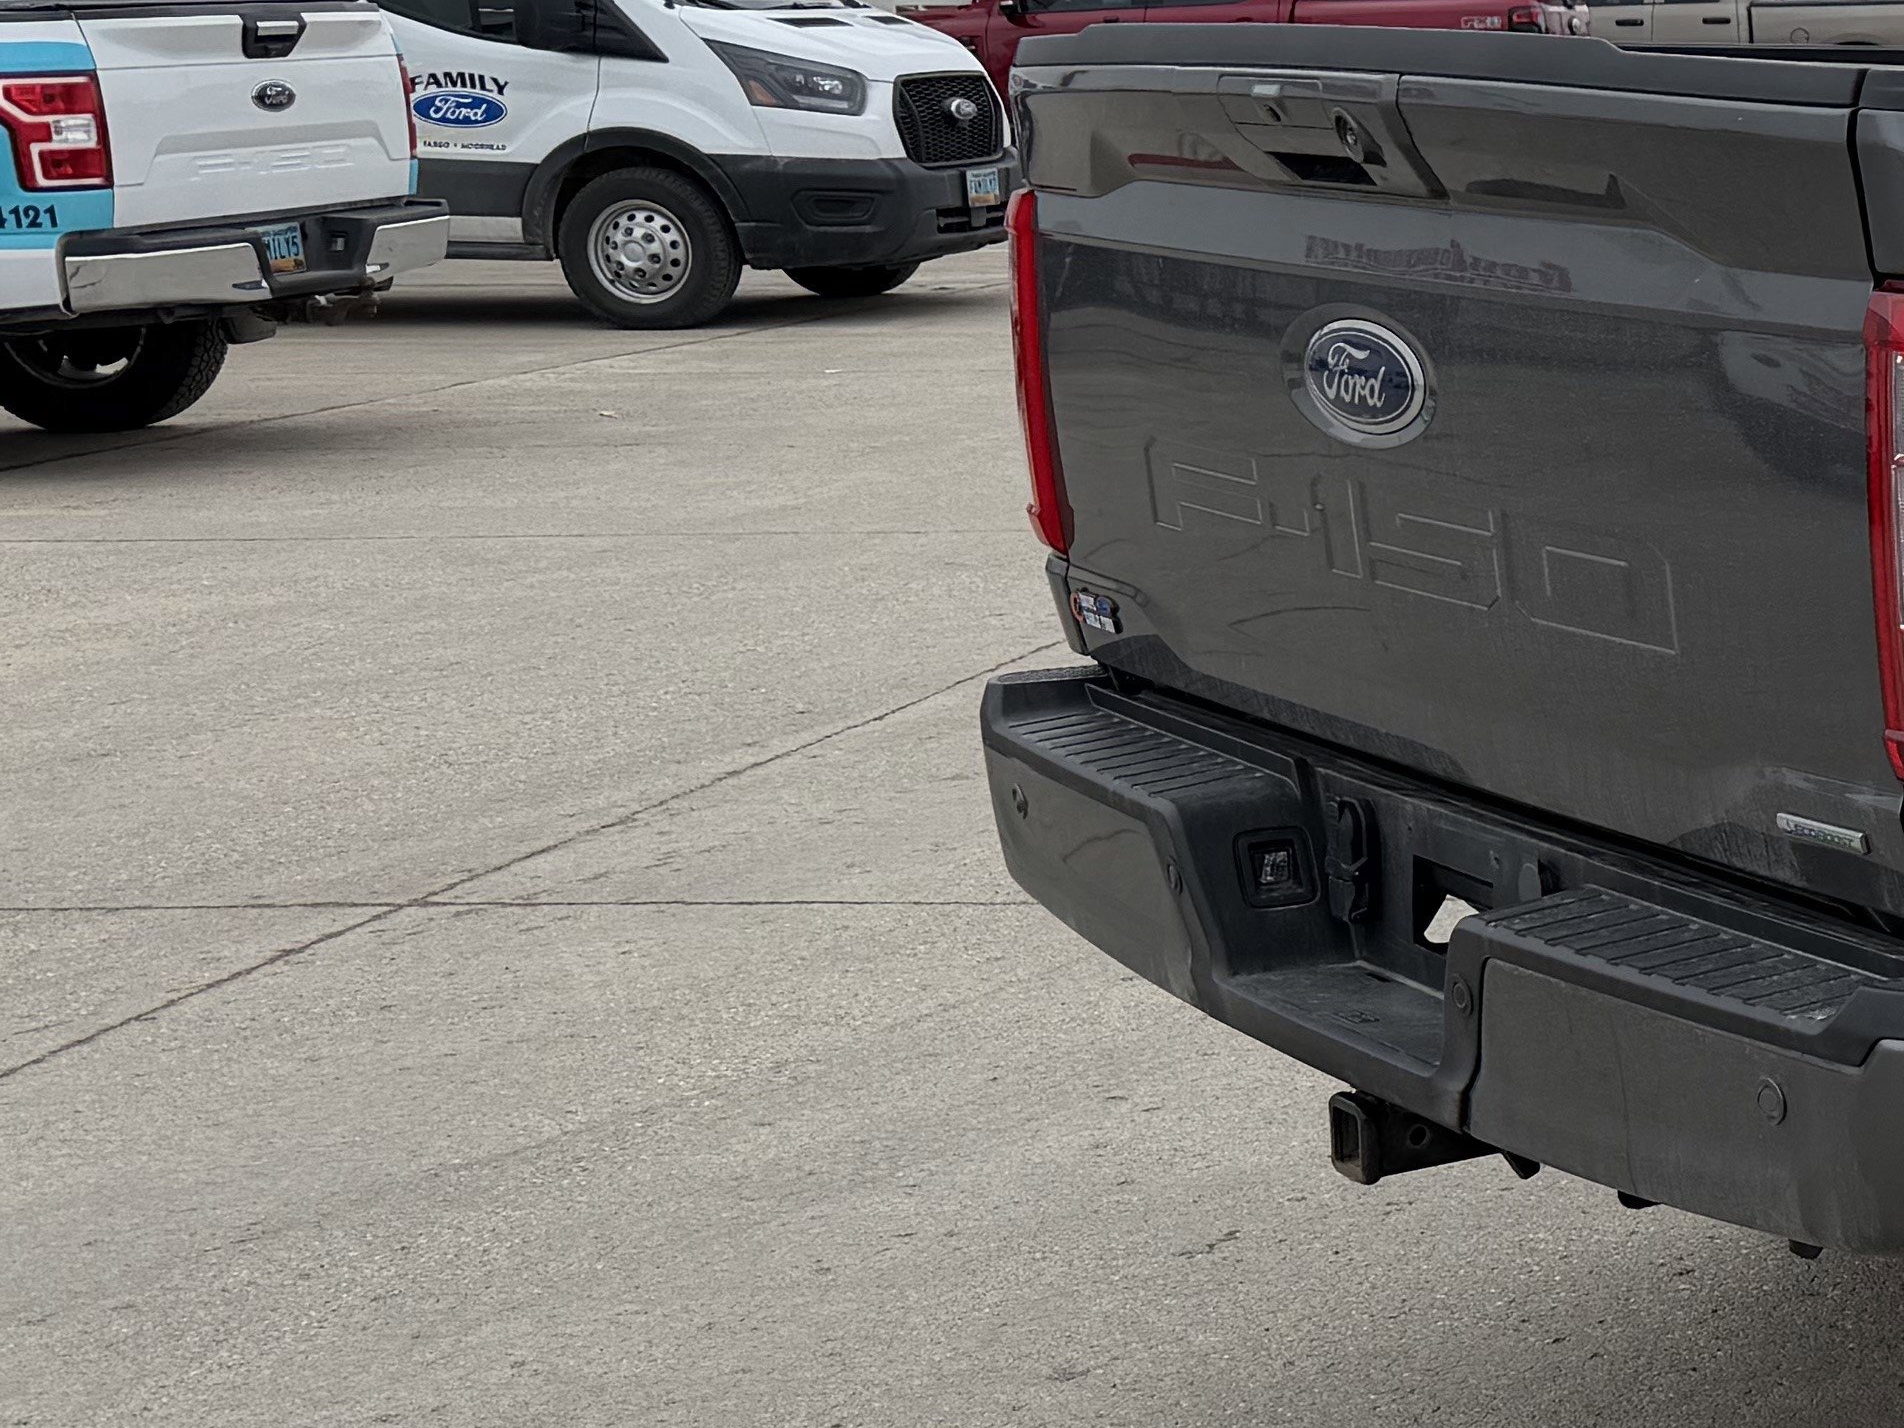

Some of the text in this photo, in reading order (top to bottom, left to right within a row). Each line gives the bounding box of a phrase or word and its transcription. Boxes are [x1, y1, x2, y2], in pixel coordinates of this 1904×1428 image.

[410, 71, 510, 97] FAMILY
[429, 95, 488, 122] Ford
[1323, 342, 1386, 408] Ford
[1143, 435, 1680, 655] F-150
